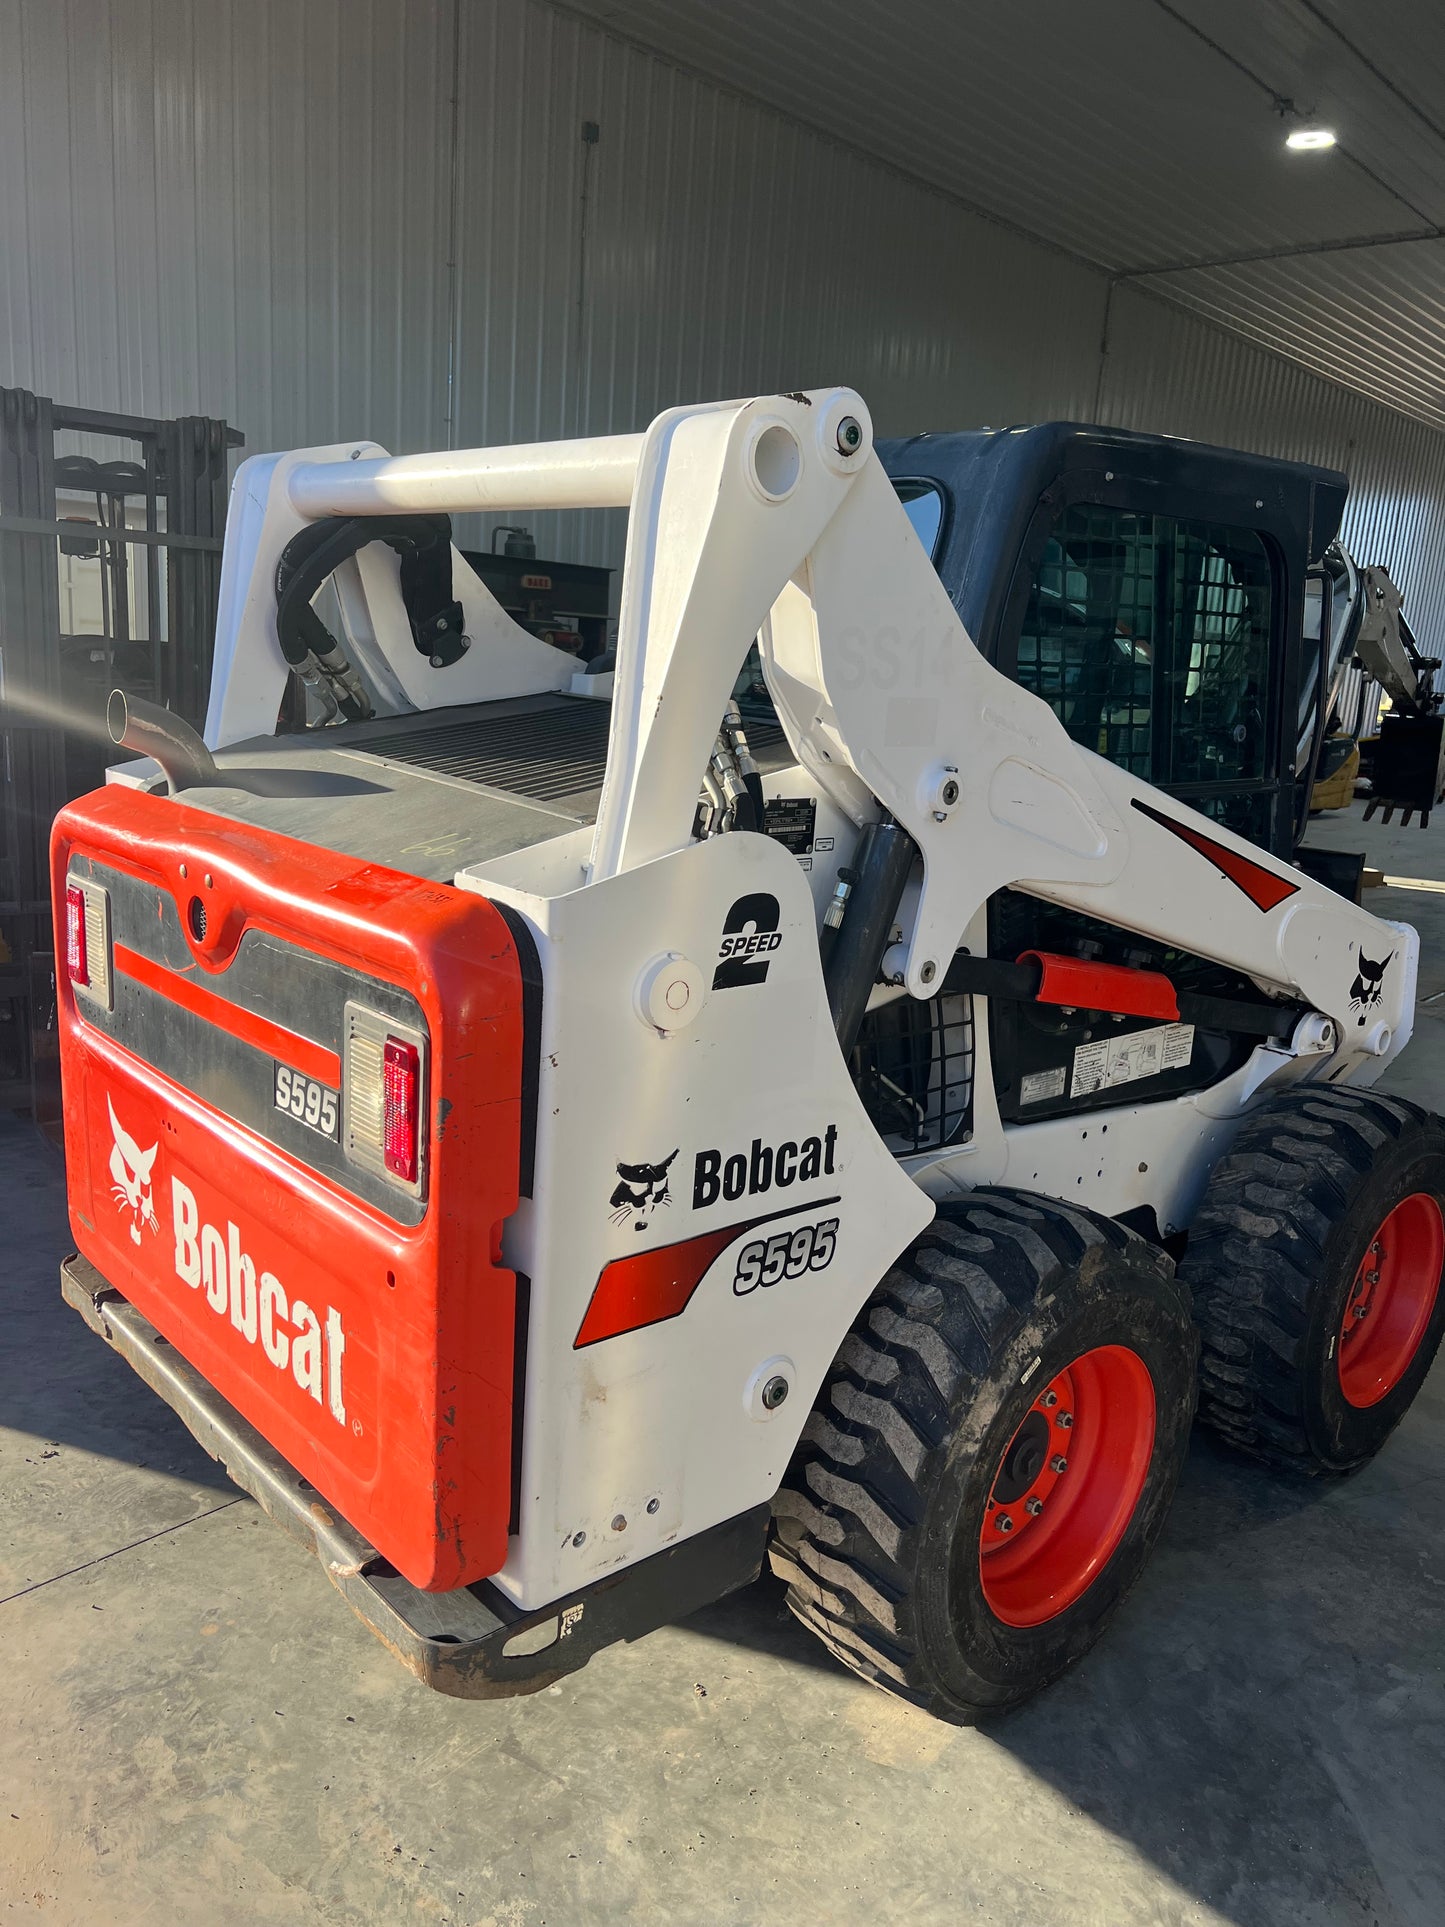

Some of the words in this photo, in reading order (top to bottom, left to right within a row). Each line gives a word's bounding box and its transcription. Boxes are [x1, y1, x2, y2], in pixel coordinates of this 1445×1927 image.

[711, 892, 780, 991] 2
[718, 933, 783, 958] SPEED
[275, 1066, 338, 1135] S595
[692, 1123, 838, 1211] Bobcat
[732, 1217, 841, 1297] S595
[171, 1174, 346, 1427] Bobcat
